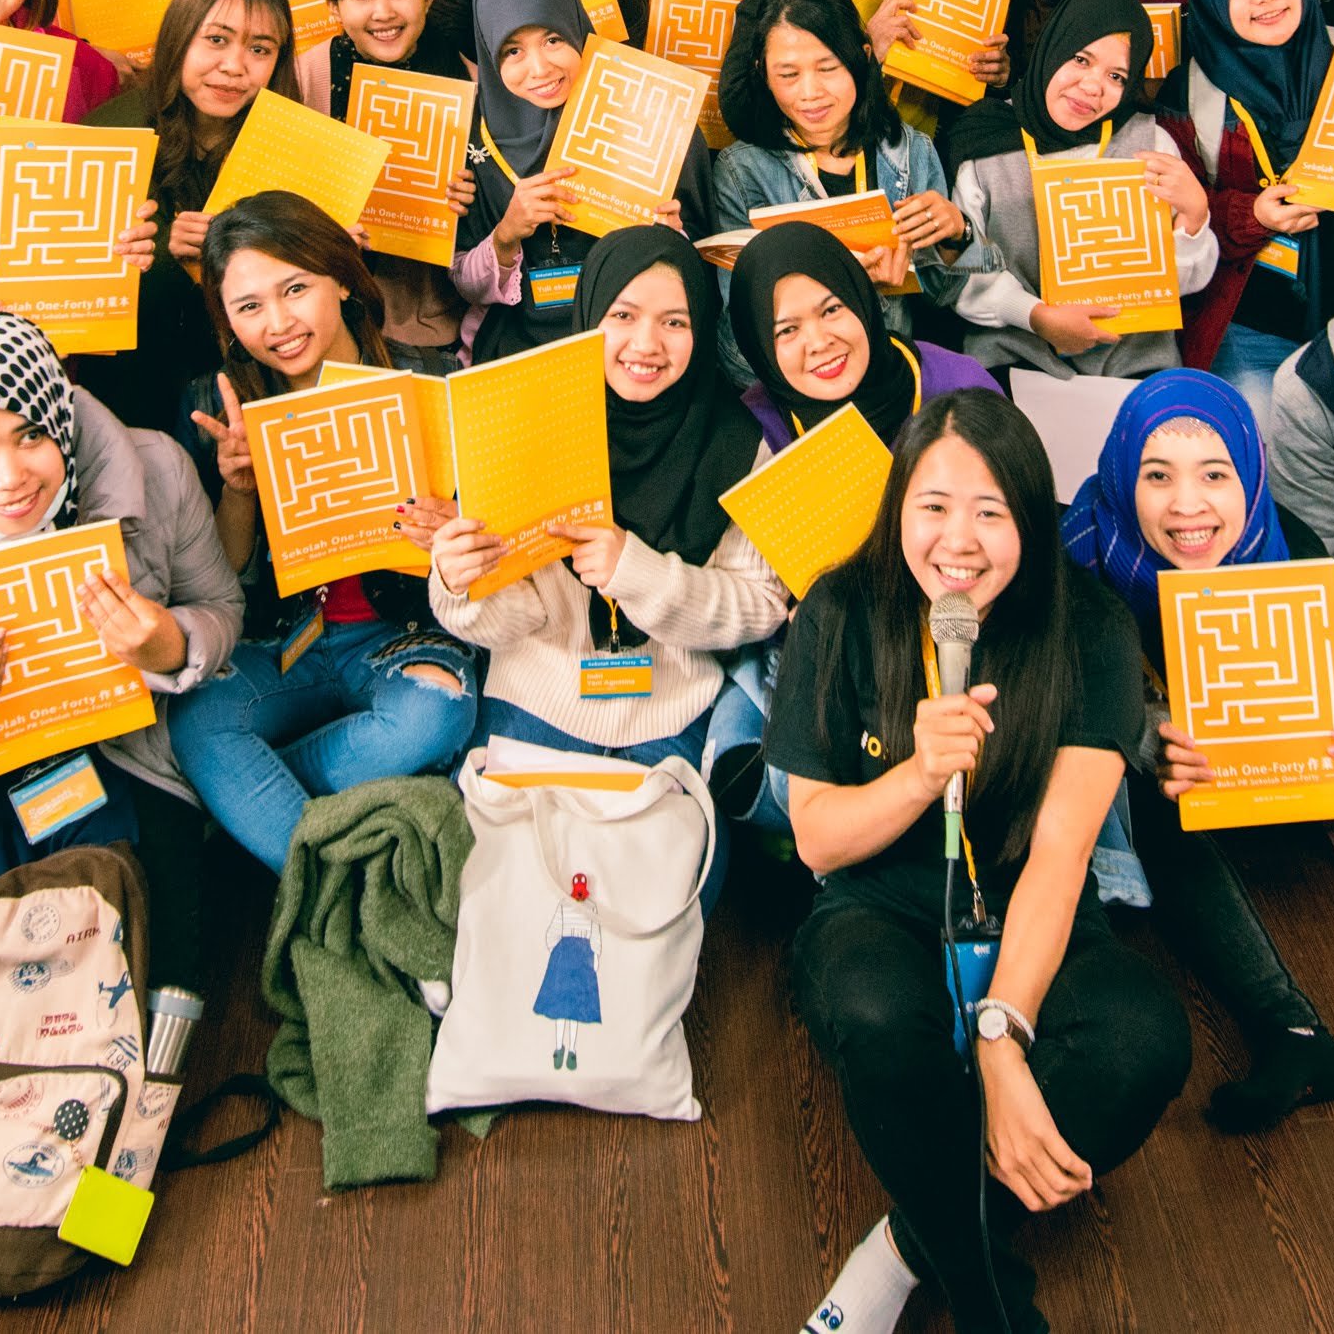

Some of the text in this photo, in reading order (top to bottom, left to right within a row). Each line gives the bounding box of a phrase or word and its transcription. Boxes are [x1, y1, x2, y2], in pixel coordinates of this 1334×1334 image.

[1302, 161, 1334, 173] Sekolah
[589, 189, 633, 210] One-Forty
[379, 208, 421, 224] One-Forty
[36, 295, 130, 311] One-Forty 作業本
[1096, 293, 1142, 304] One-Forty
[518, 514, 567, 542] One-Forty
[570, 501, 604, 518] 中文課
[281, 539, 328, 561] Sekolah
[330, 526, 389, 546] One-Forty
[29, 695, 98, 721] One-Forty
[99, 680, 141, 703] 作業本
[1241, 761, 1305, 777] One-Forty
